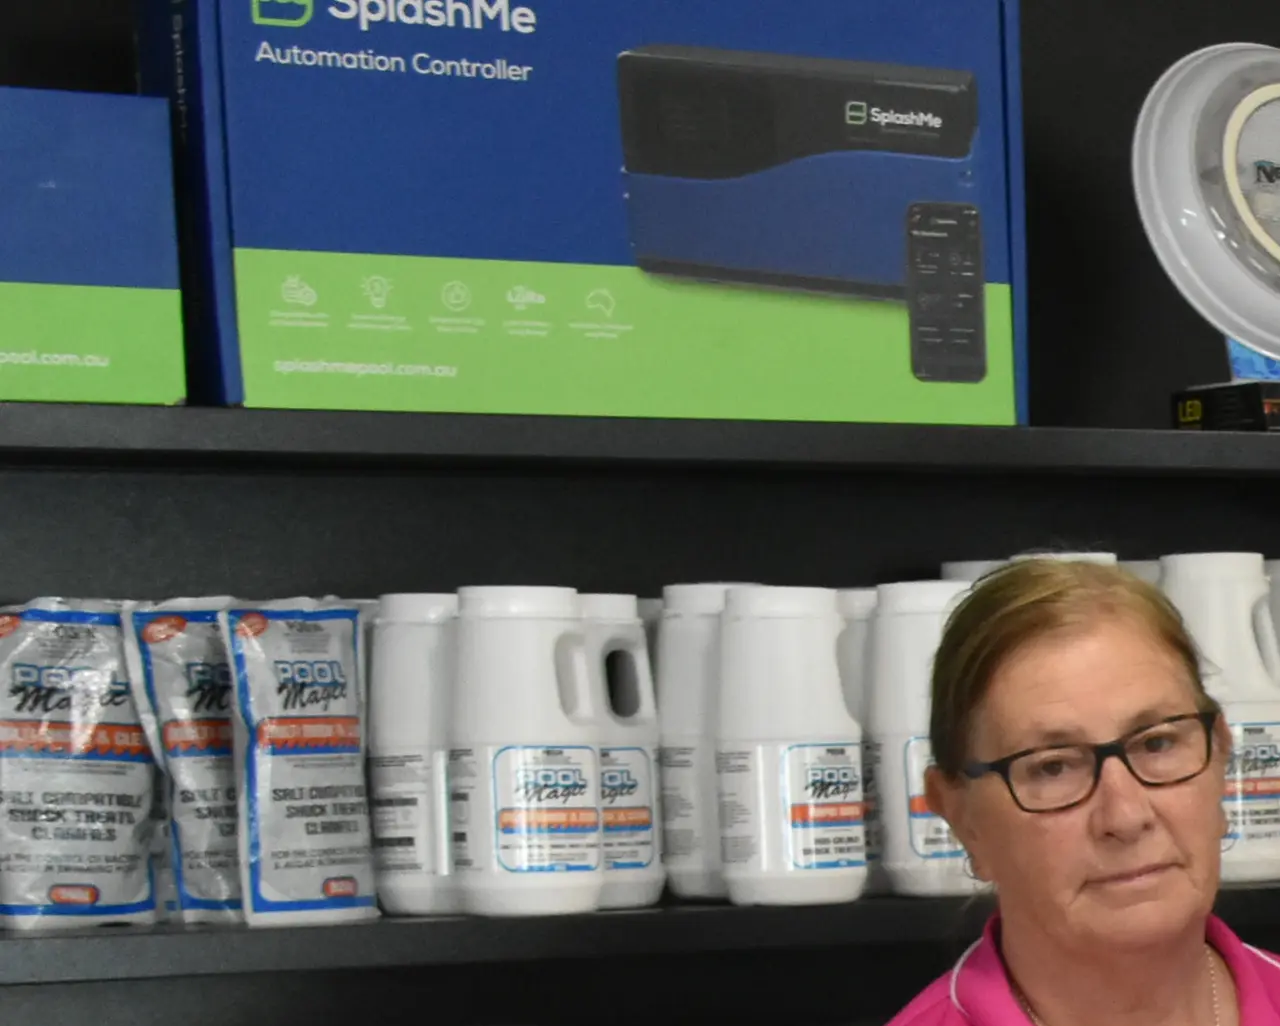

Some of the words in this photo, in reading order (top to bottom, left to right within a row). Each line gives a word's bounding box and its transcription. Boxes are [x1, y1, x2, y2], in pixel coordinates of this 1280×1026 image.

[328, 0, 537, 34] SplashMe
[255, 41, 405, 73] Automation
[412, 53, 532, 82] Controller
[870, 107, 943, 128] SplashMe
[273, 357, 459, 378] splashmepool.com.au
[12, 662, 131, 696] POL
[274, 661, 346, 688] POOL
[277, 683, 348, 712] Magic
